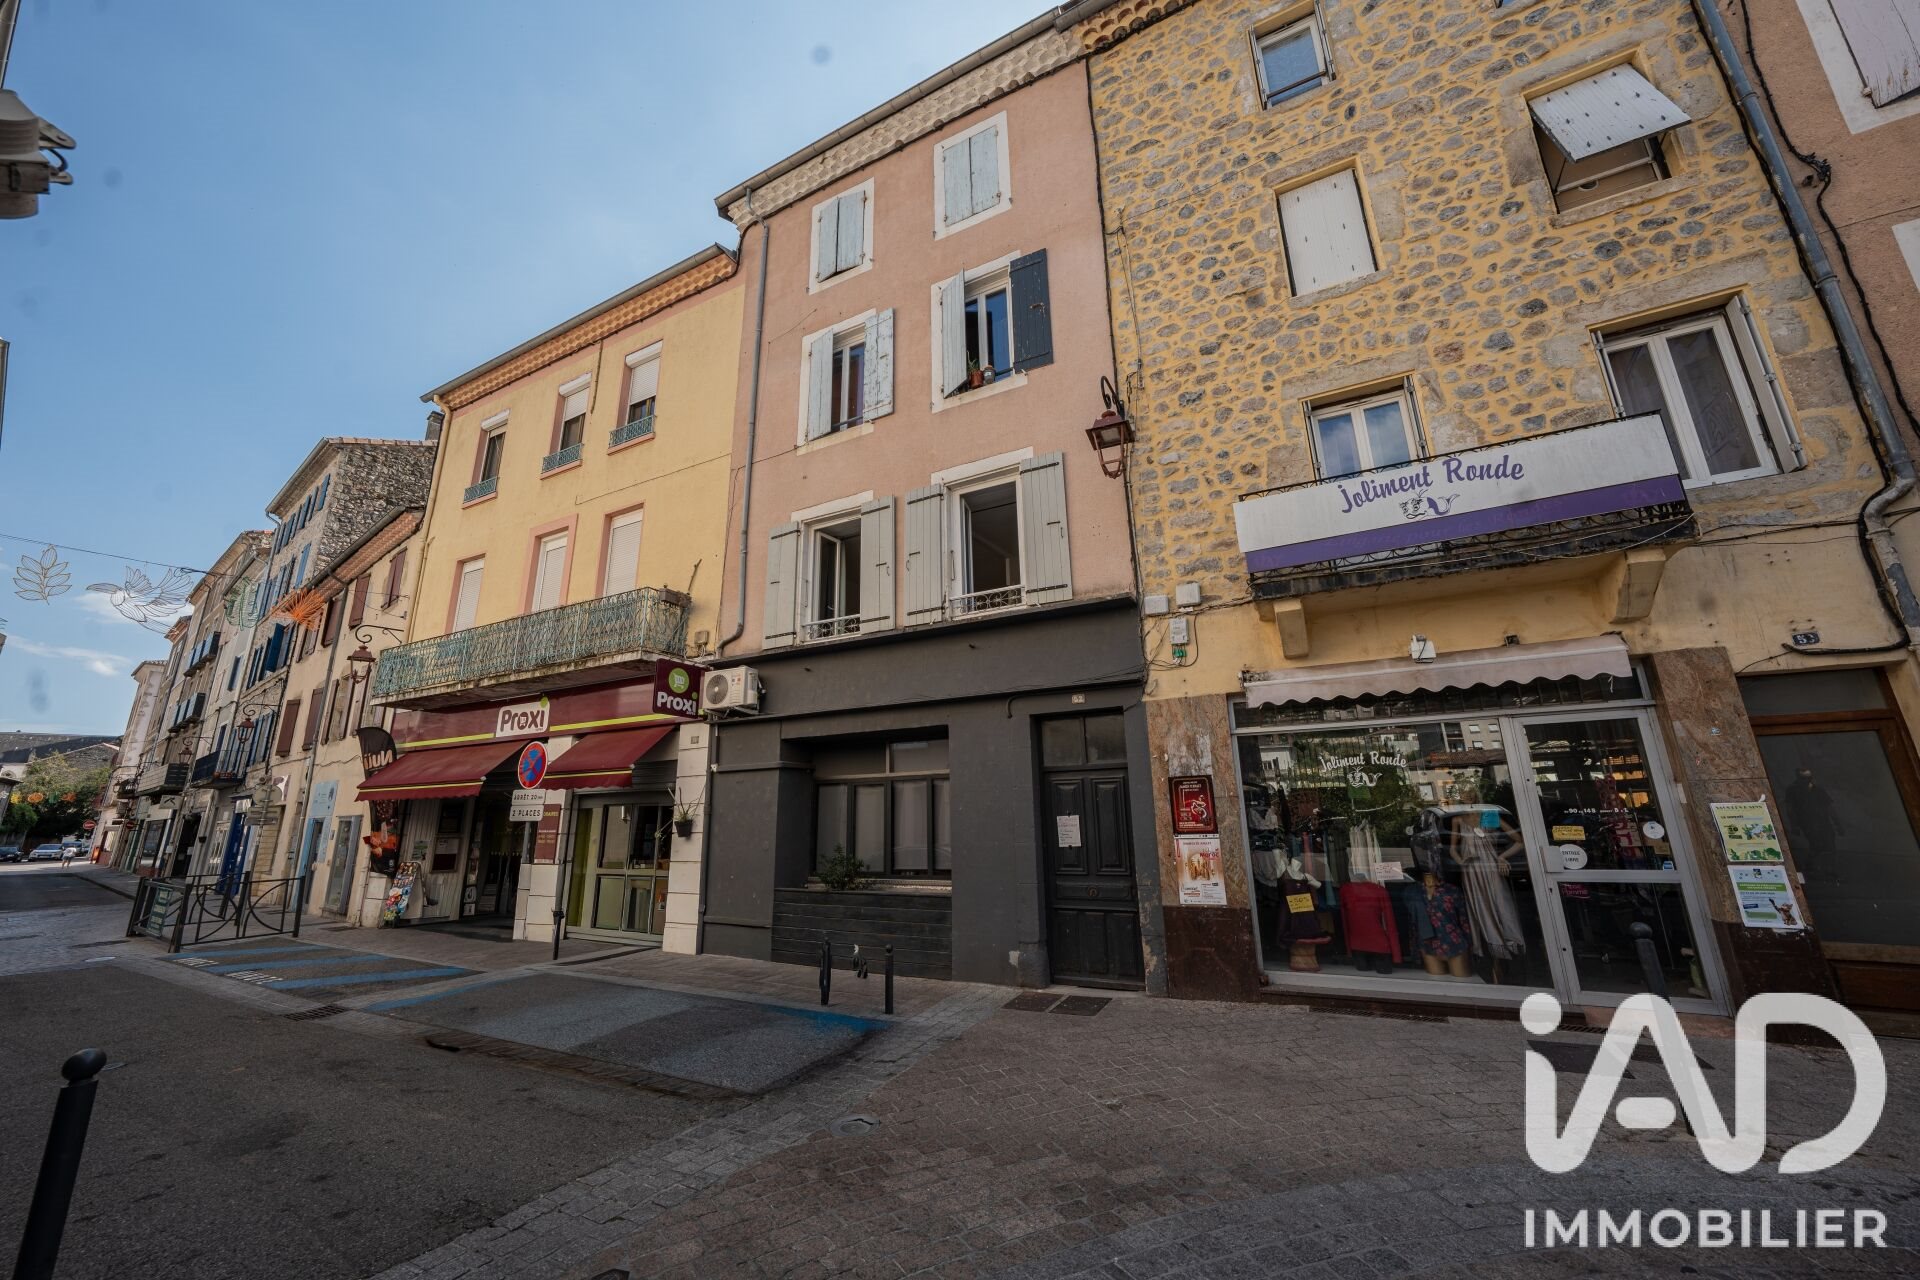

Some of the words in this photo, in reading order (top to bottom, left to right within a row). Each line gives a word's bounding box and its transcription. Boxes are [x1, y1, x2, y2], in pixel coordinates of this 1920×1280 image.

[1337, 465, 1434, 514] Joliment
[1442, 454, 1525, 483] Ronde
[657, 691, 697, 713] Proxi
[500, 708, 546, 732] Proxi
[1319, 752, 1366, 773] Joliment
[1369, 750, 1407, 768] Ronde
[511, 809, 516, 817] 2
[519, 809, 541, 817] PLACES
